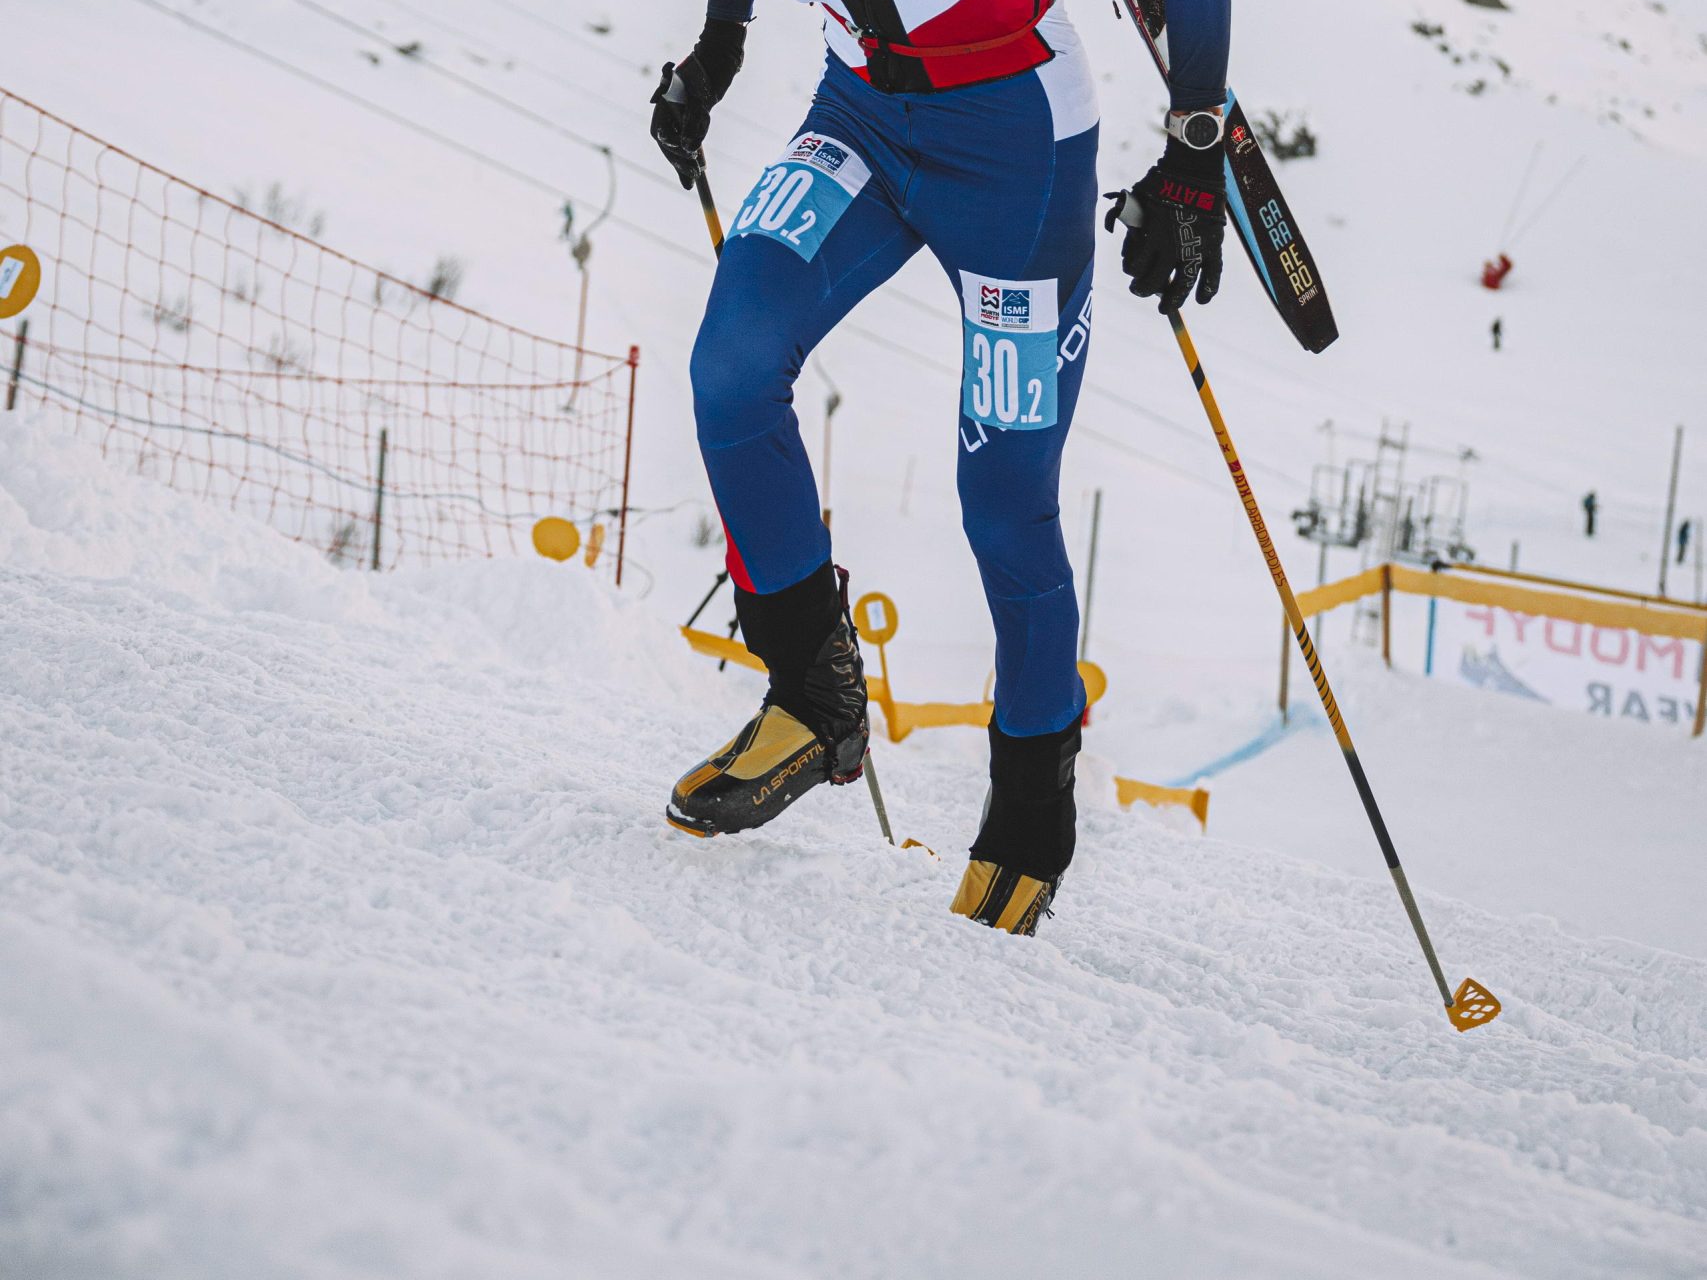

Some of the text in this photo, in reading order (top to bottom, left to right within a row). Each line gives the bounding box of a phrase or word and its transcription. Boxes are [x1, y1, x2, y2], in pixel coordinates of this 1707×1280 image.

[817, 150, 841, 166] ISMF
[736, 166, 817, 246] 30.2
[1160, 180, 1199, 205] ATK
[1259, 198, 1283, 229] GA
[1268, 220, 1293, 251] RA
[1279, 243, 1303, 275] AE
[1289, 264, 1313, 296] RO
[1298, 285, 1319, 306] SPRINT
[1004, 306, 1028, 315] ISMF
[972, 332, 1043, 424] 30.2
[1244, 498, 1272, 548] CARBON
[1263, 548, 1288, 587] POLES
[752, 786, 771, 806] LA
